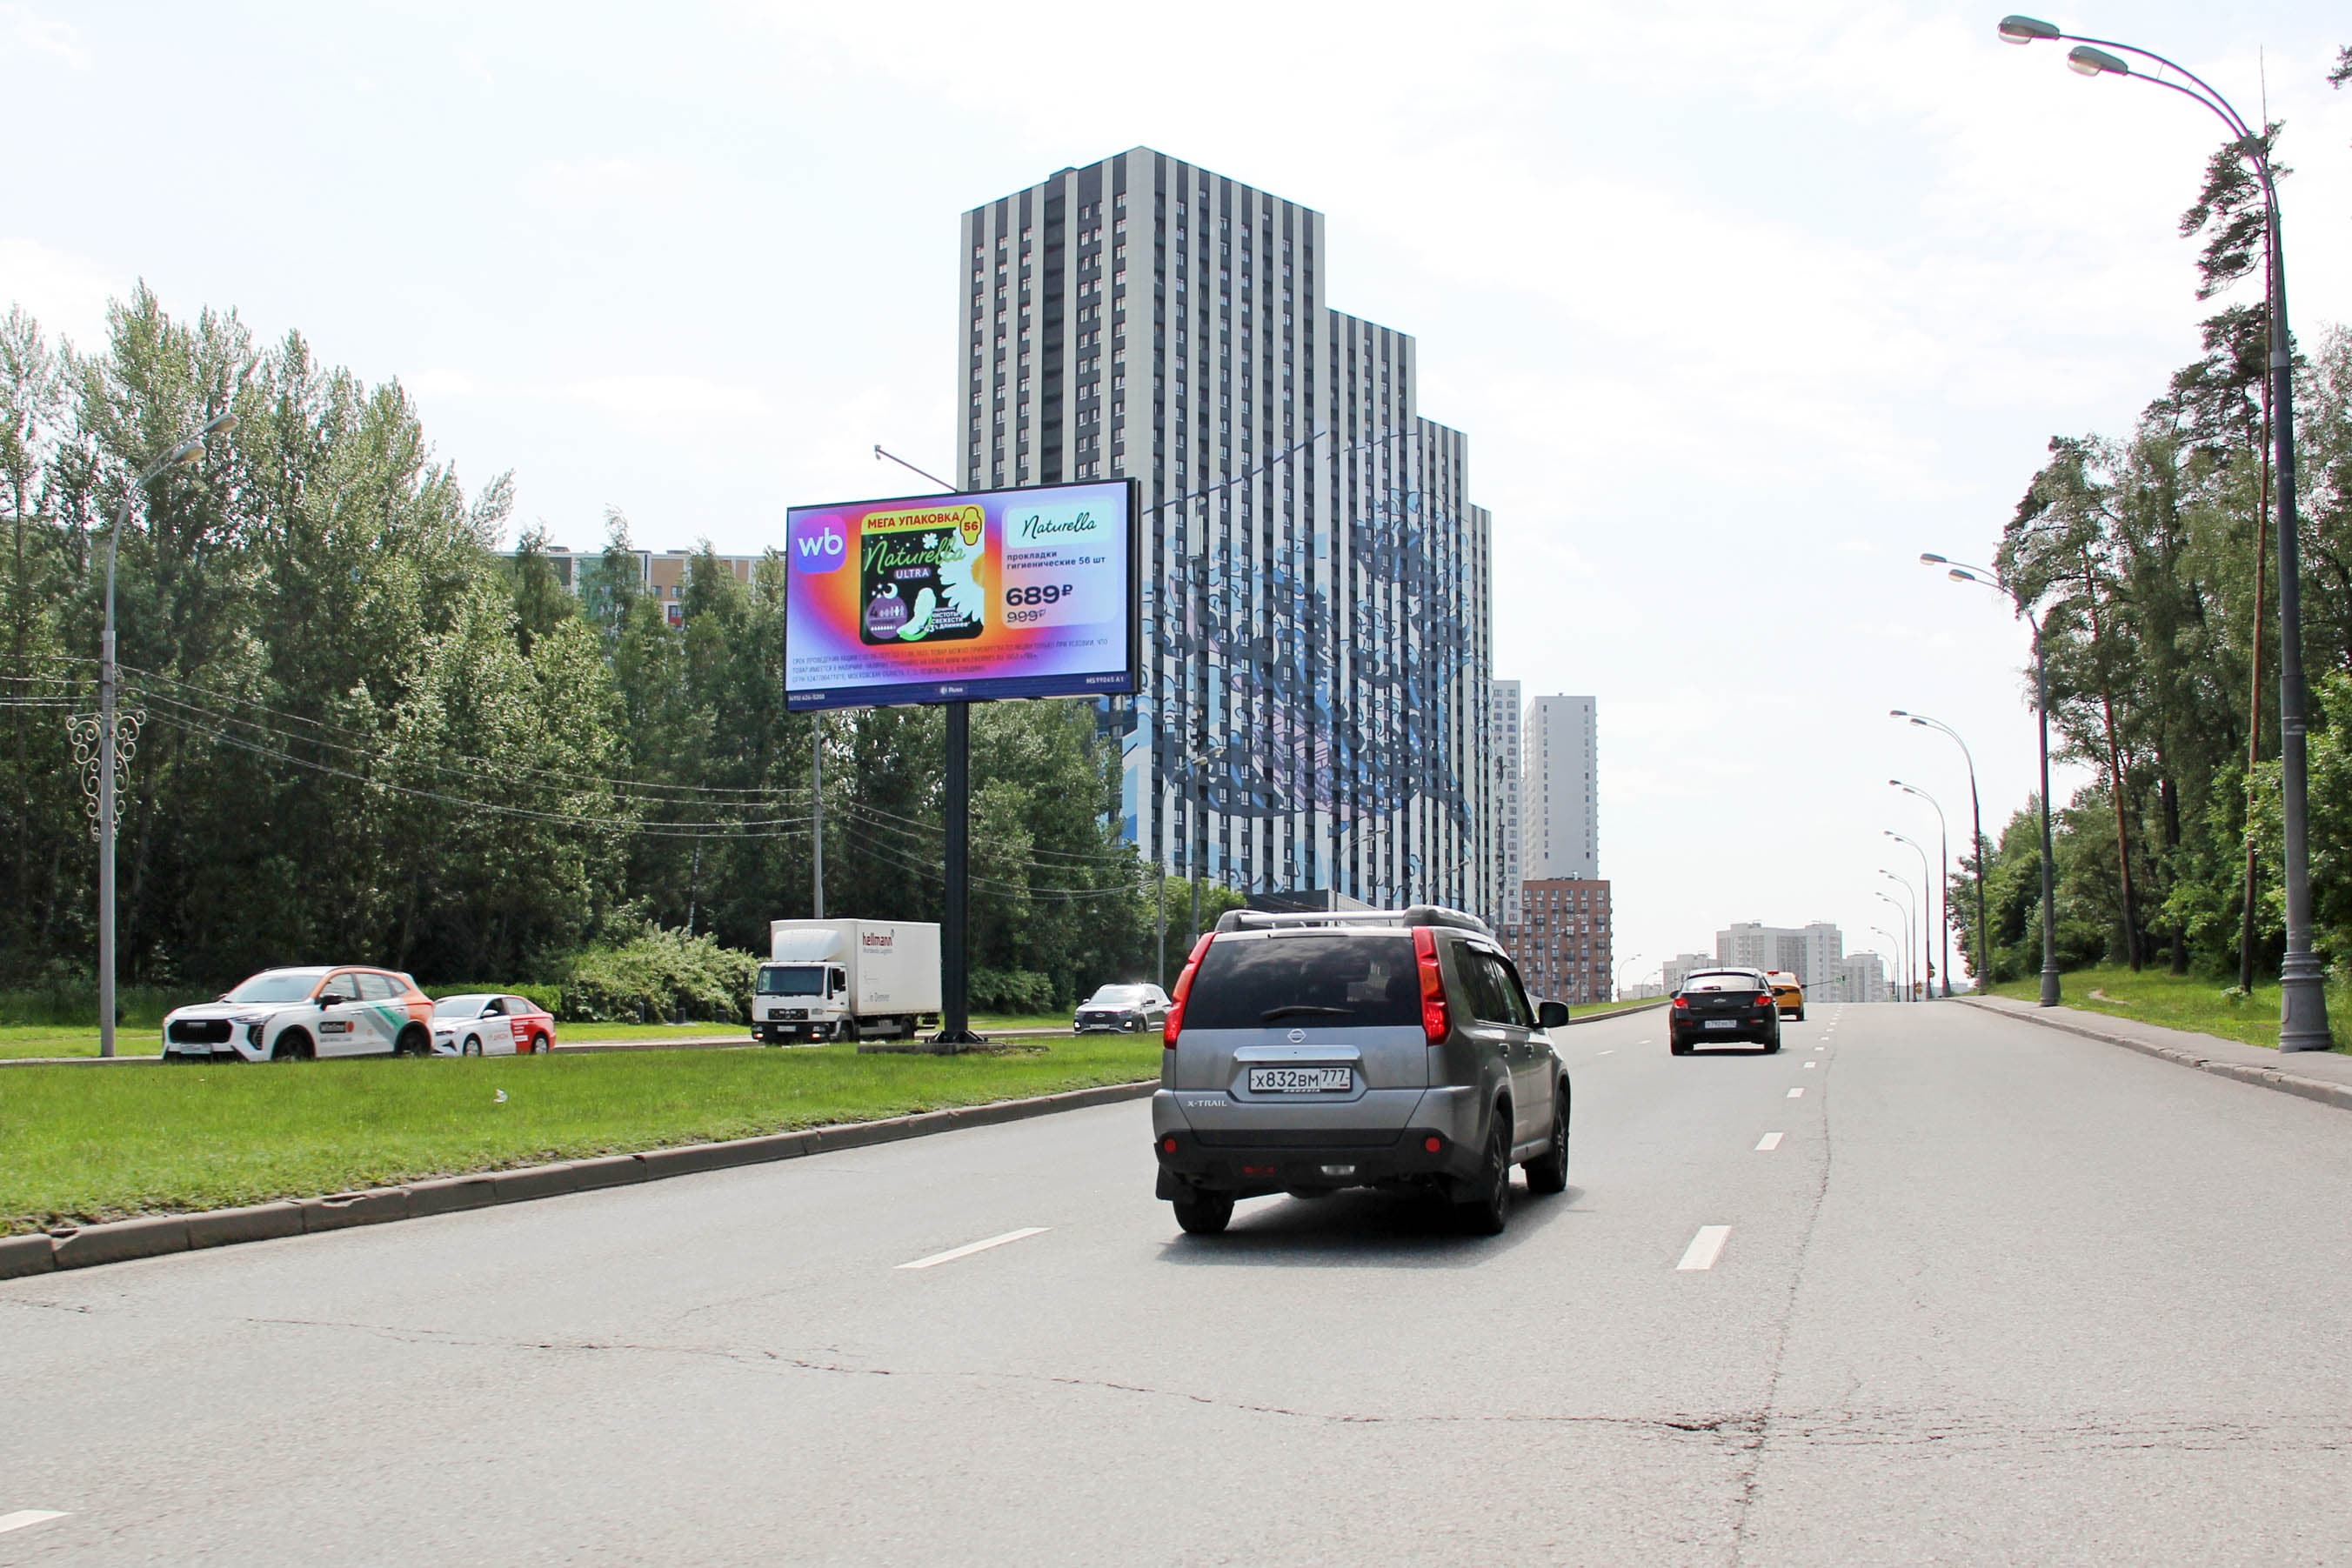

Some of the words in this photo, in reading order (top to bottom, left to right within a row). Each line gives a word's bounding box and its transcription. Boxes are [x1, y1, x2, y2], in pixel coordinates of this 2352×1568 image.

[868, 517, 895, 529] МЕГА
[899, 512, 959, 526] УПАКОВКА
[964, 521, 979, 531] 56
[1022, 511, 1097, 539] Naturella
[798, 527, 843, 557] wb
[864, 536, 966, 575] Naturella
[1007, 550, 1058, 562] прокладки
[1007, 557, 1076, 570] гигиенические
[896, 568, 930, 579] ULTRA
[862, 931, 893, 946] hellmann
[1321, 1069, 1346, 1082] 777
